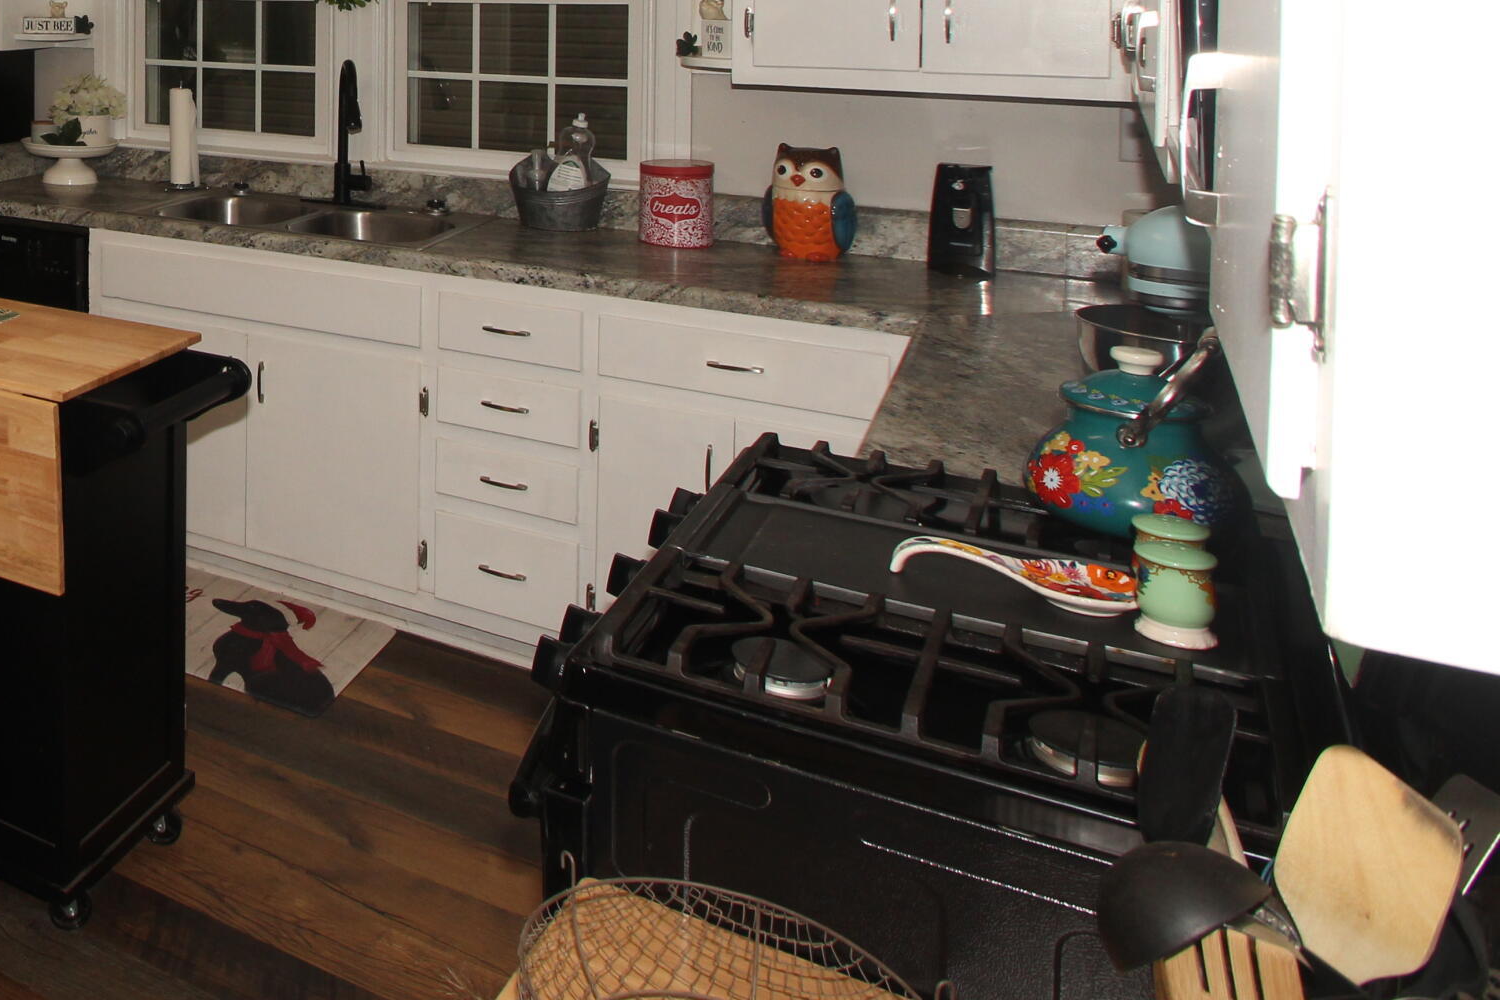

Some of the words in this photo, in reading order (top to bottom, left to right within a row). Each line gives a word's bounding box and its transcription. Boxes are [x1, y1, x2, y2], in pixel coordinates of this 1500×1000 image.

[25, 20, 51, 31] JUST
[53, 20, 73, 31] BEE
[653, 200, 698, 216] treats
